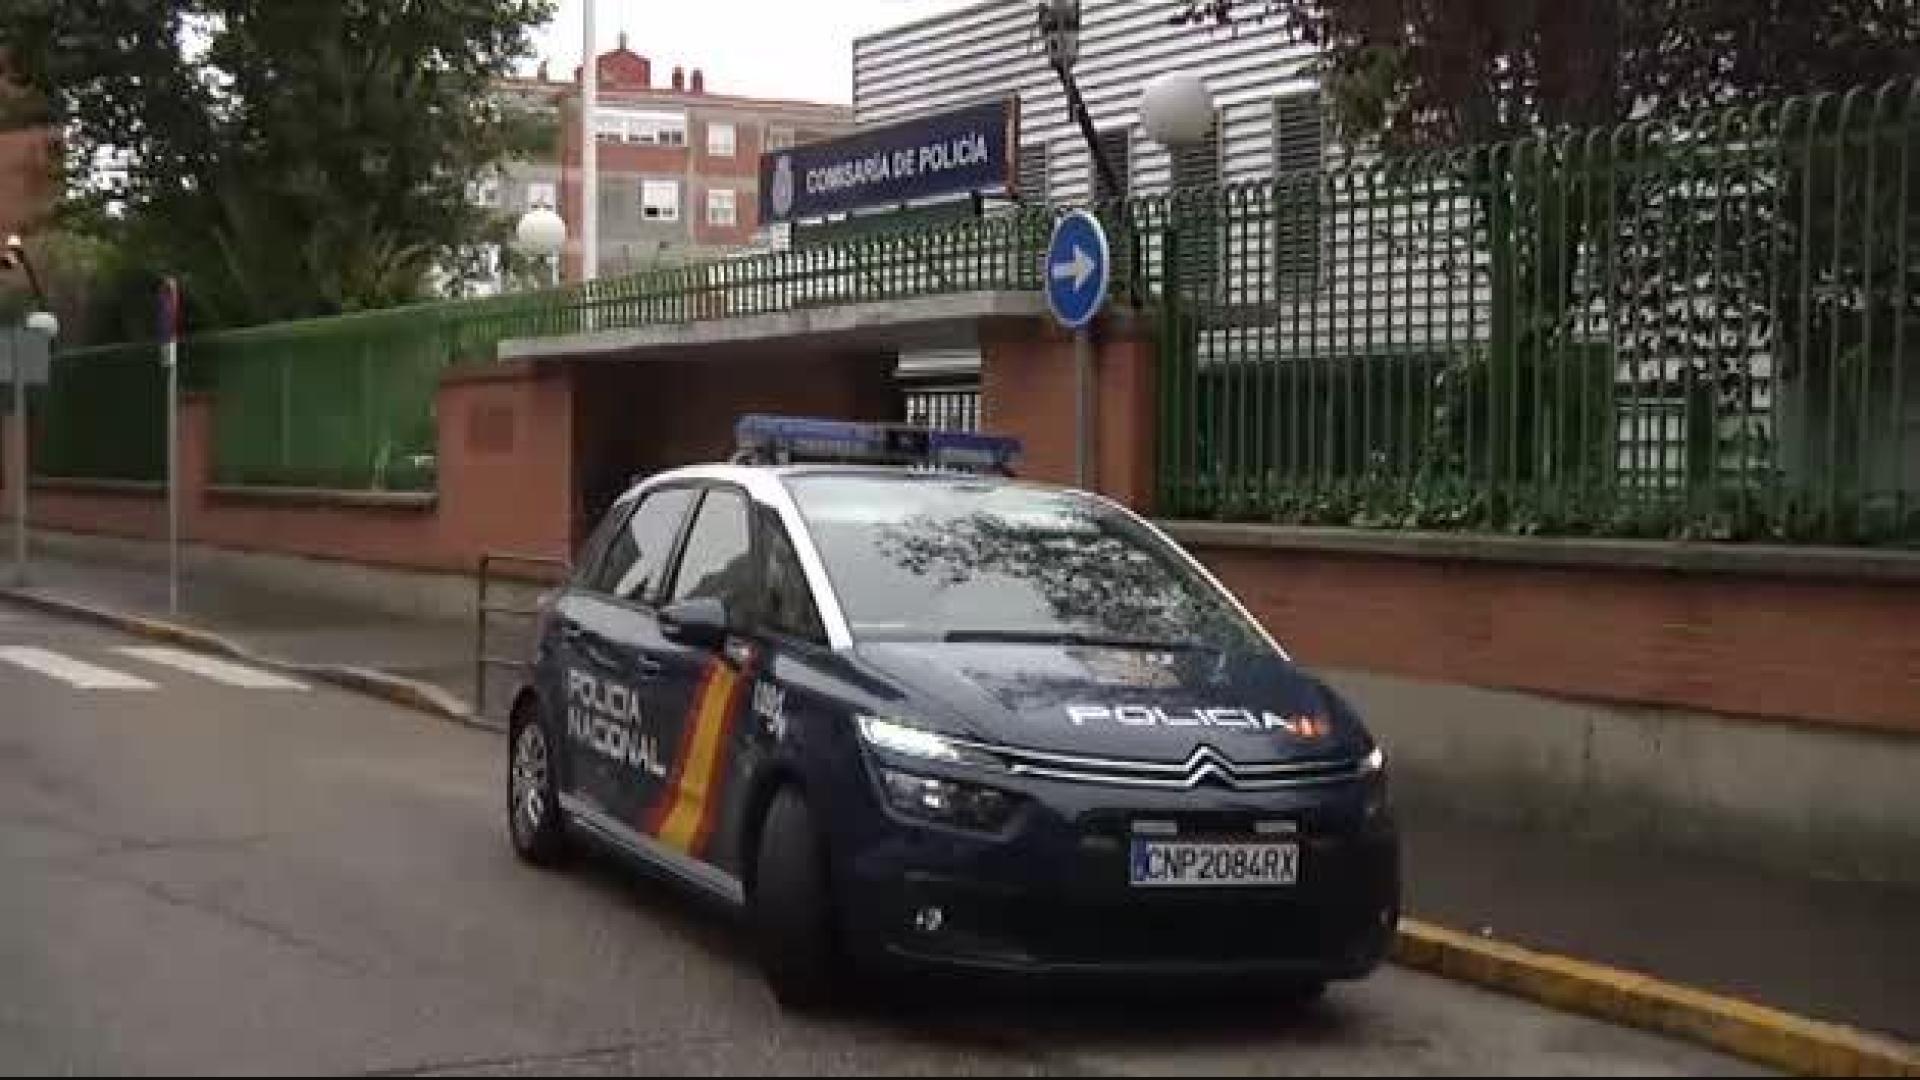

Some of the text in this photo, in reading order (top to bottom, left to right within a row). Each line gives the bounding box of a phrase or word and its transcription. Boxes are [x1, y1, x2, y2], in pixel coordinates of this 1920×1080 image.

[893, 149, 915, 179] DE
[1067, 705, 1298, 730] POLICIA
[567, 704, 667, 777] NACIONAL
[1146, 848, 1297, 880] CNP2084RX
